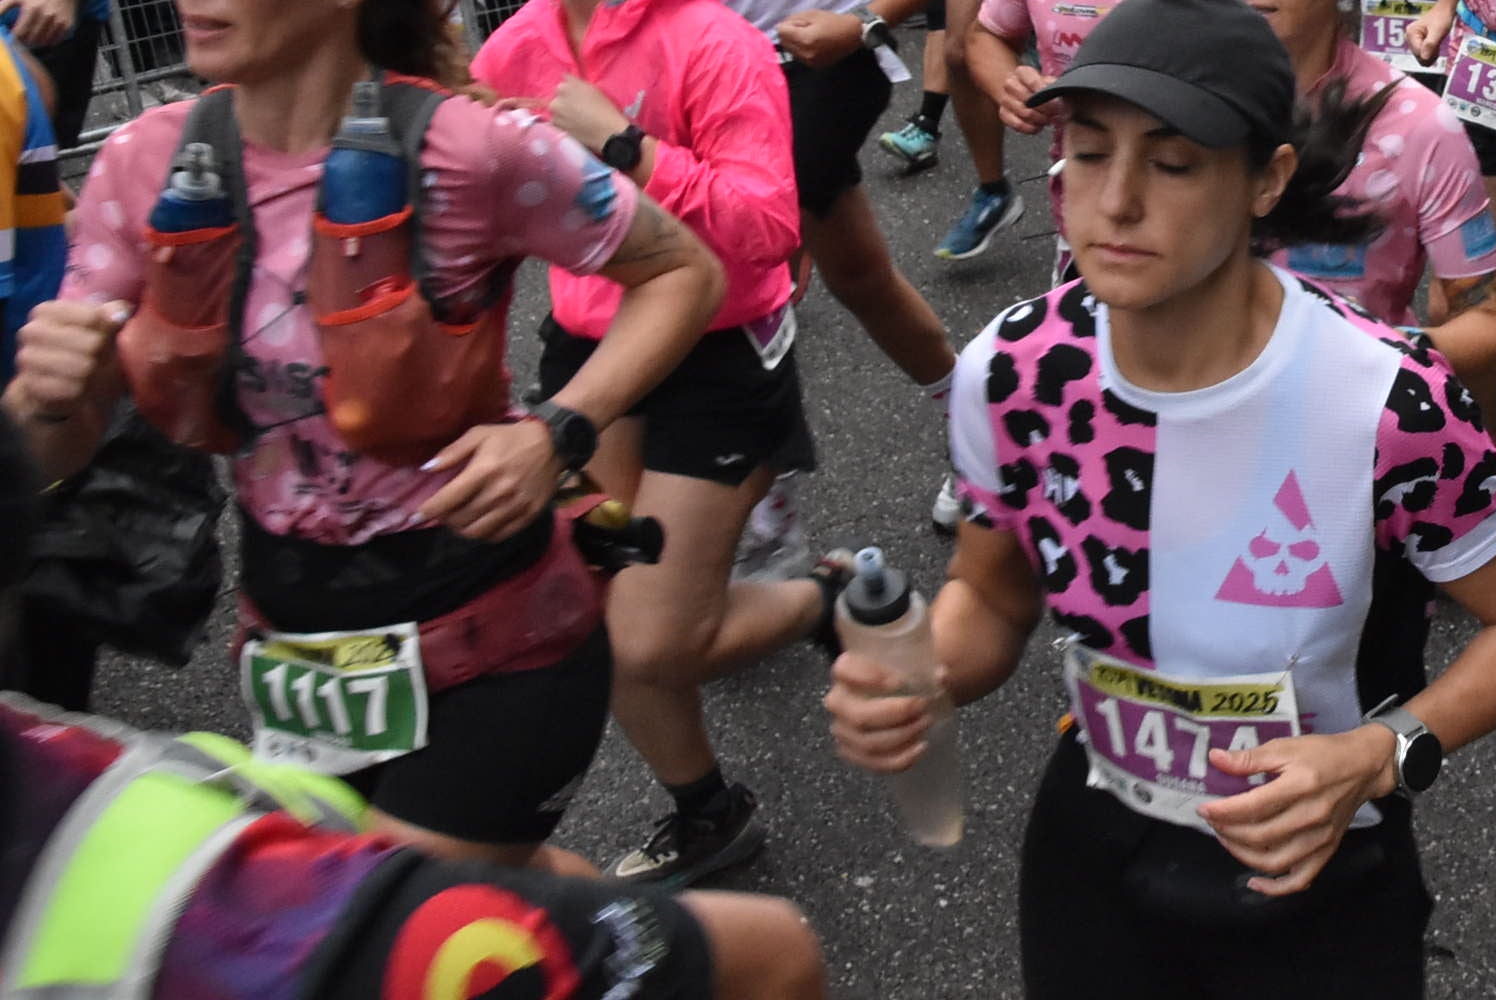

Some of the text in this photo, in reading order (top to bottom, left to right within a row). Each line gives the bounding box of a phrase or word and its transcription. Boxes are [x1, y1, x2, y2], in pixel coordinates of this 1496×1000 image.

[1372, 17, 1406, 48] 15
[262, 662, 389, 737] 1117
[1210, 689, 1279, 715] 2025
